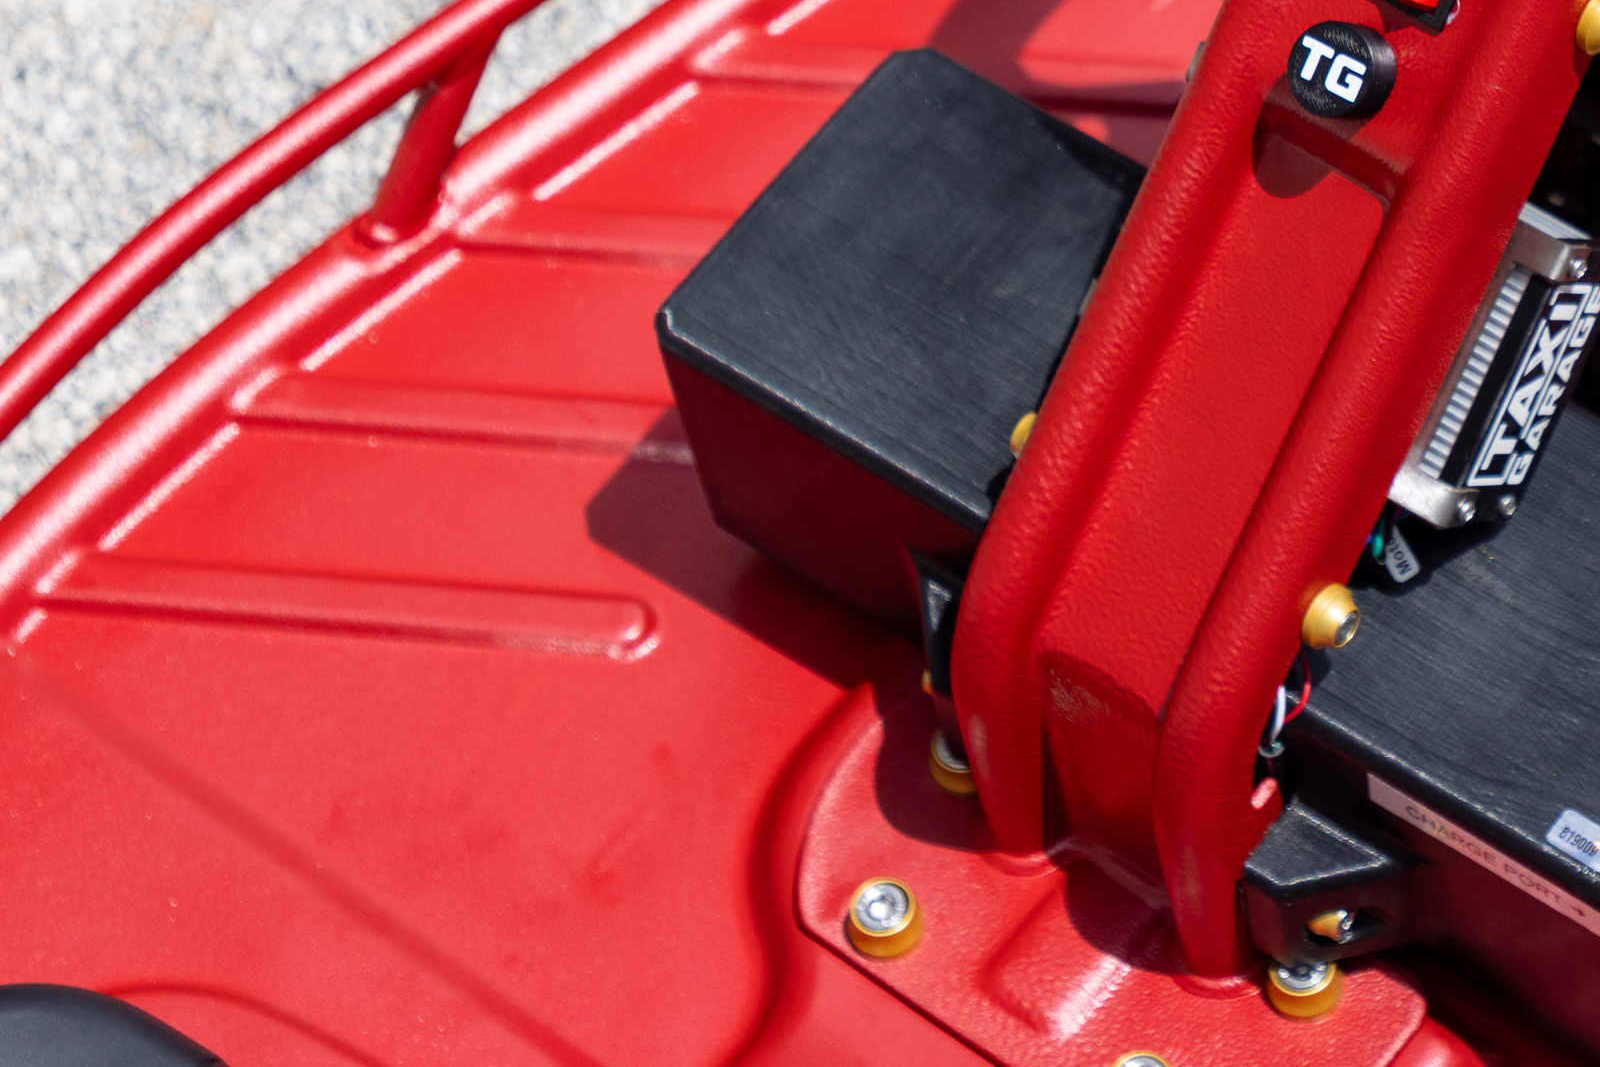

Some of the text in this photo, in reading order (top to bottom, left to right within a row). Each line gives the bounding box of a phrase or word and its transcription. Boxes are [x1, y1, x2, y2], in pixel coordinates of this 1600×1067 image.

[1300, 35, 1367, 103] TG
[1478, 300, 1581, 473] TAXI
[1406, 806, 1563, 904] CHARGE PORT
[1559, 827, 1600, 857] 819009
